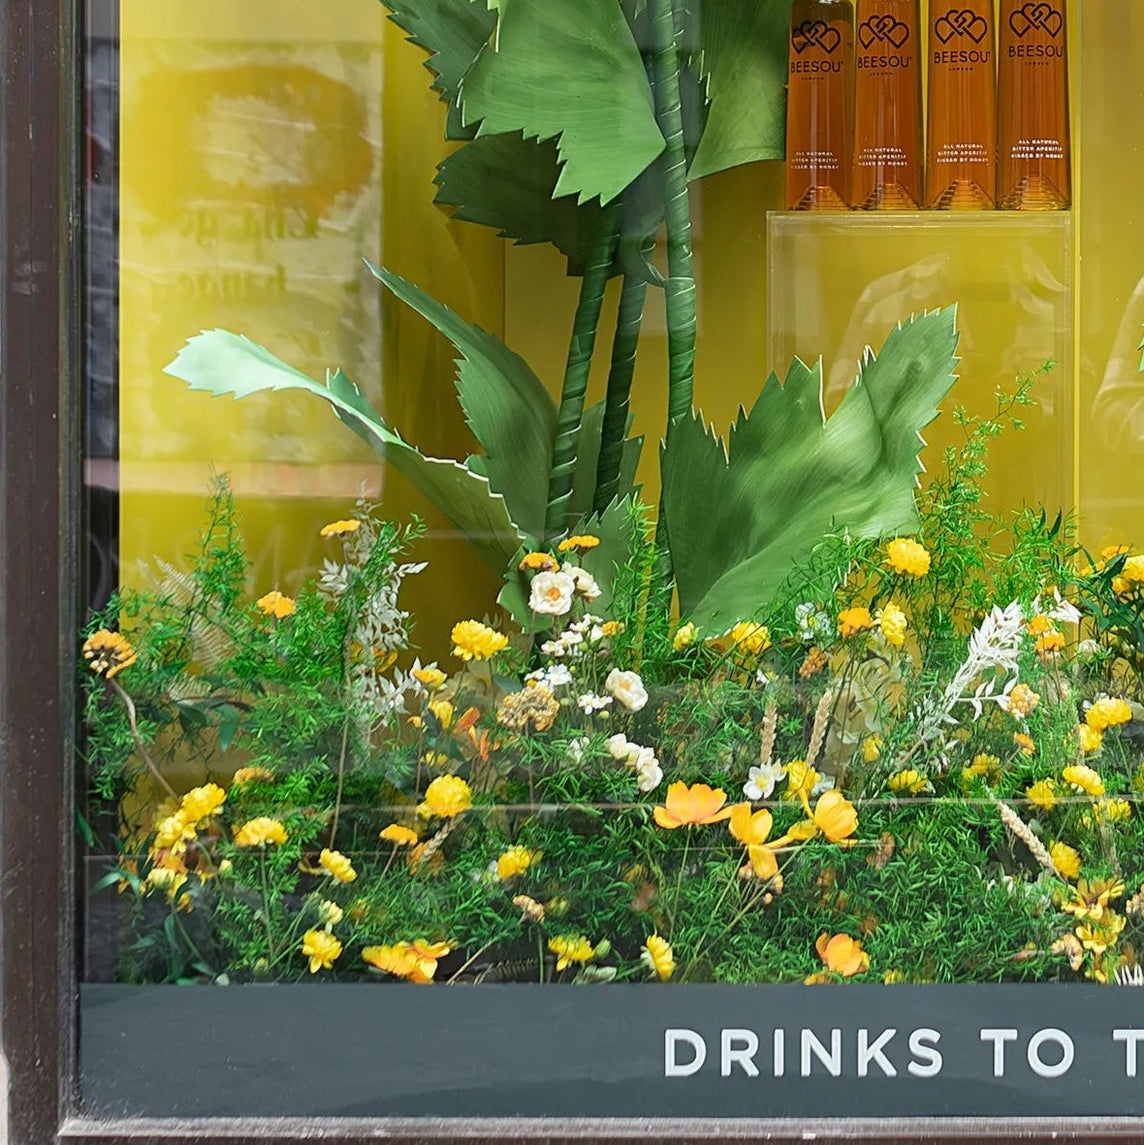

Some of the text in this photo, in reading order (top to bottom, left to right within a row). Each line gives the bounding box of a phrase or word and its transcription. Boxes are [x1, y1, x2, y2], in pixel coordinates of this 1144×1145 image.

[934, 51, 988, 64] BEESOU
[1009, 45, 1063, 57] BEESOU
[791, 61, 840, 73] BEESOU
[858, 56, 909, 69] BEESOU
[664, 1028, 944, 1078] DRINKS
[981, 1028, 1075, 1078] TO
